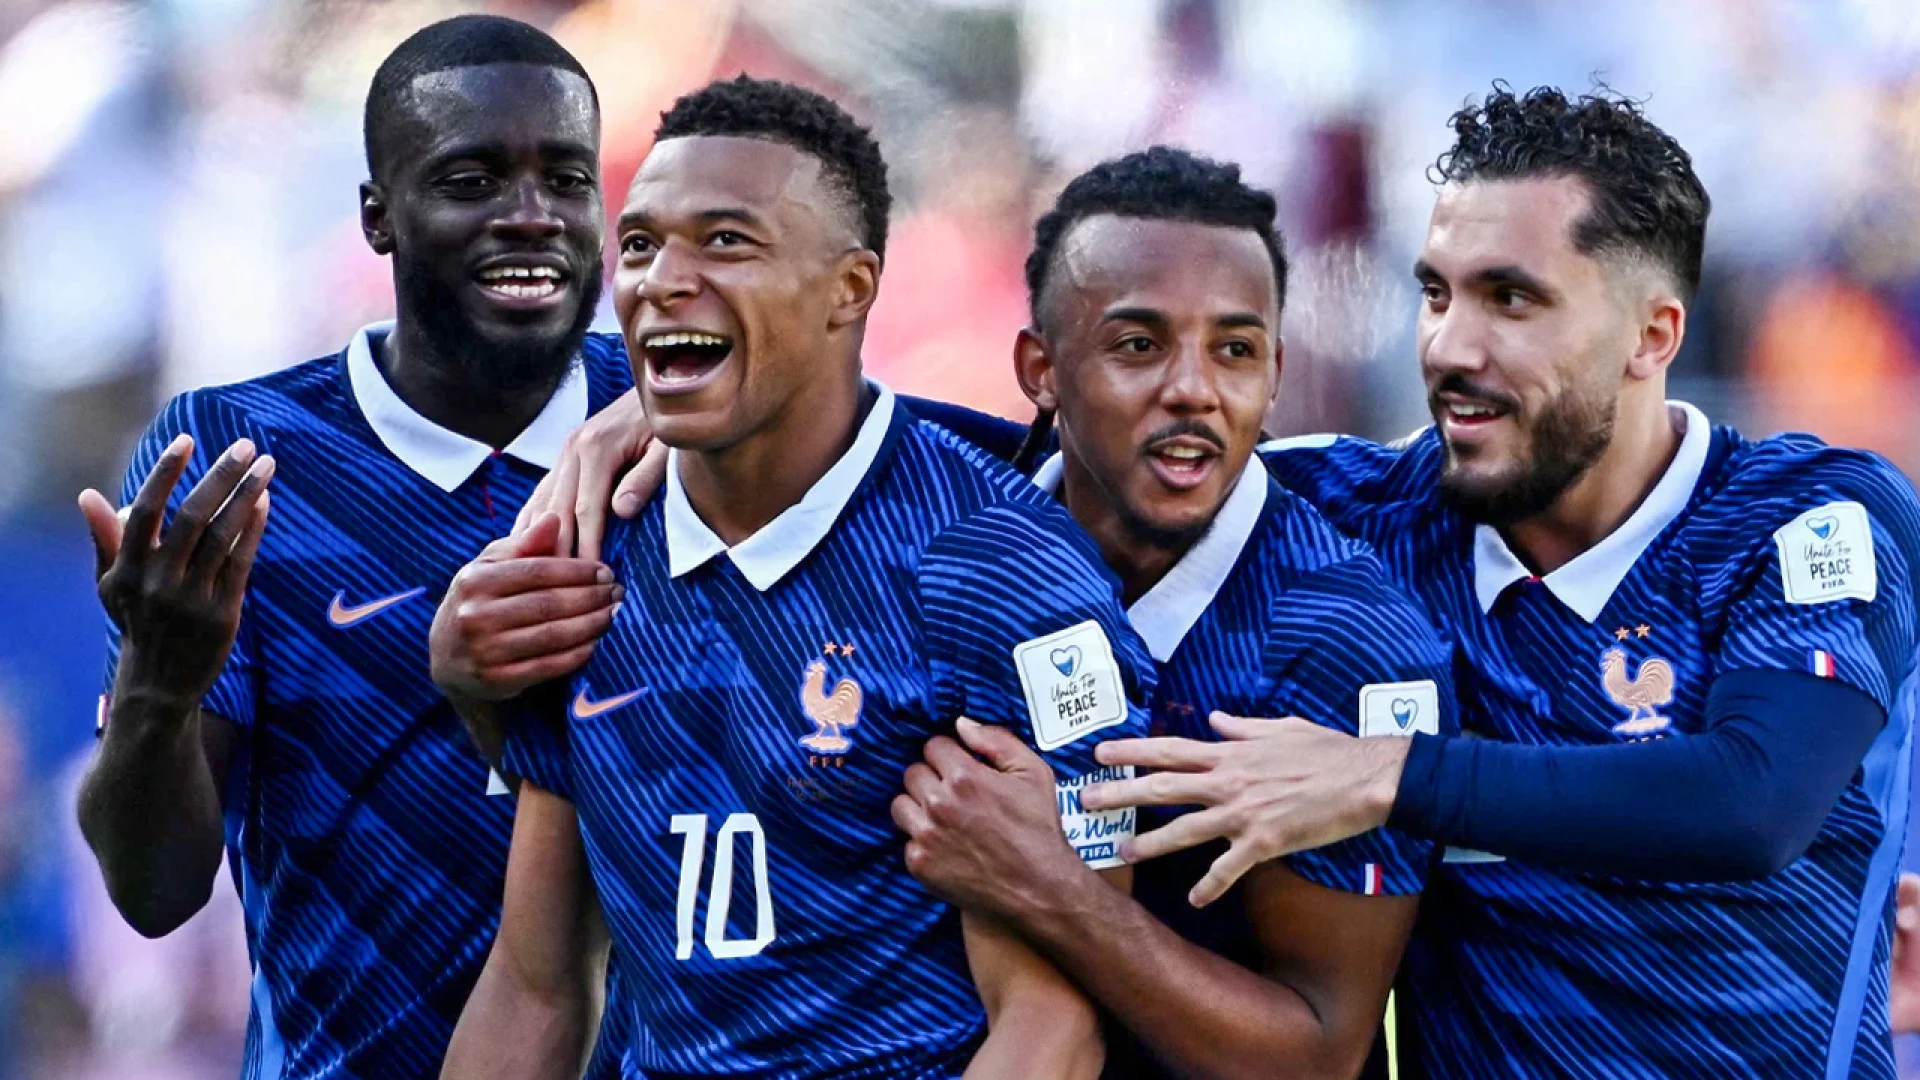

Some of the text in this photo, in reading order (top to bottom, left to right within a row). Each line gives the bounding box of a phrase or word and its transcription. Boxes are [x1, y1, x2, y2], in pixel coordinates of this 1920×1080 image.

[1810, 558, 1853, 580] PEACE
[1822, 578, 1846, 590] FIFA
[1057, 690, 1098, 720] PEACE
[1069, 714, 1091, 727] FIFA
[1084, 810, 1135, 839] World
[1080, 845, 1111, 859] FIFA
[669, 812, 776, 960] 10
